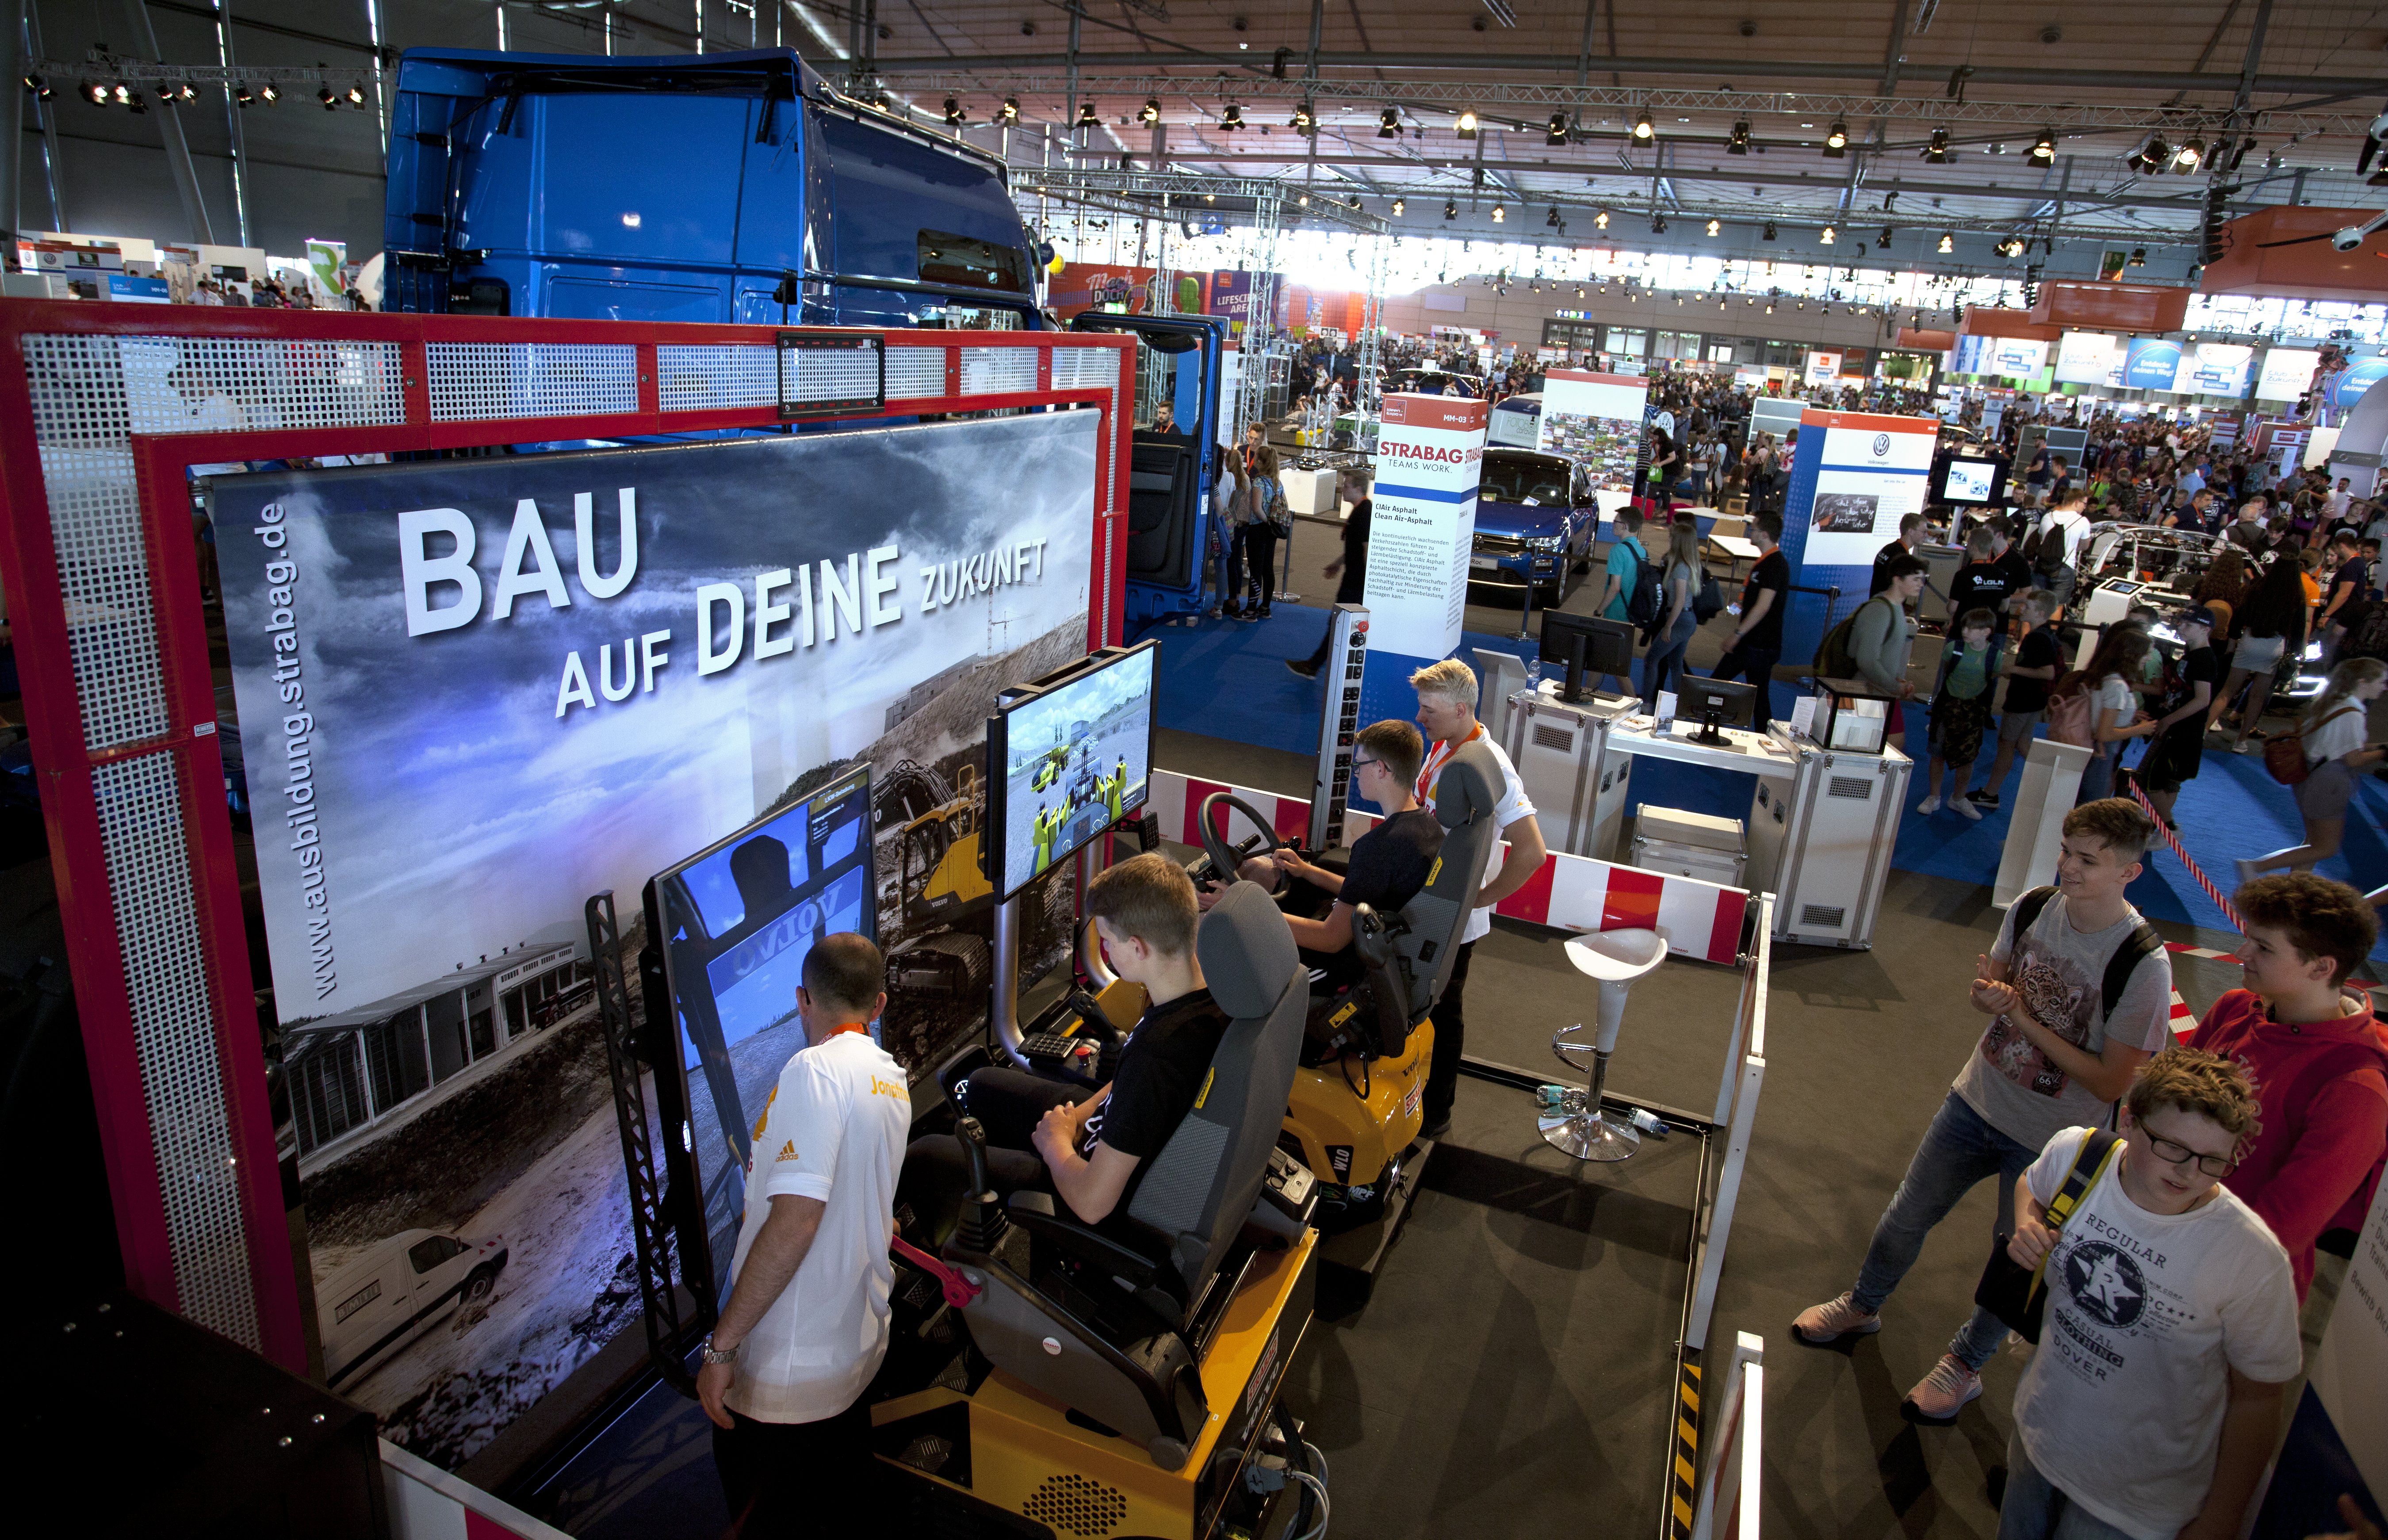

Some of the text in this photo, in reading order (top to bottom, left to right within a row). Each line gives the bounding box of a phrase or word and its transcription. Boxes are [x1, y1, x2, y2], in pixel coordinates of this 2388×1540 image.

[1086, 270, 1135, 290] Mach
[1094, 289, 1124, 302] DOCH
[2140, 359, 2170, 368] Entdecke
[2156, 368, 2173, 377] Weg!
[1443, 414, 1467, 423] MM-03
[1379, 441, 1463, 464] STRABAG
[1465, 445, 1483, 464] STRABAG
[1389, 459, 1453, 474] TEAMS WORK.
[1395, 515, 1432, 525] Air-Asphalt
[1835, 515, 1851, 524] how
[1860, 505, 1875, 520] why
[1372, 538, 1408, 547] Verkehrszahlen
[1382, 532, 1416, 541] kontinuierlich
[398, 487, 638, 638] BAU
[1371, 551, 1412, 561] Lärmbelästigung.
[1370, 564, 1406, 574] Asphaltschicht,
[1410, 563, 1437, 571] konzipierte
[1369, 571, 1412, 581] photokatalytische
[1405, 582, 1431, 591] Minderung
[1408, 589, 1444, 599] Lärmbelastung
[555, 536, 1047, 718] AUF DEINE ZUKUNFT
[254, 502, 337, 1001] www.ausbildung.strabag.de
[1429, 863, 1439, 882] VOLVO
[2039, 1076, 2051, 1085] 66
[871, 1075, 911, 1103] Jonatha
[1198, 1077, 1210, 1102] VOLVO
[1406, 1081, 1421, 1111] STRAB
[775, 1153, 799, 1162] adidas
[2085, 1213, 2167, 1269] REGULAR
[2065, 1308, 2114, 1350] CASUAL
[2056, 1311, 2121, 1367] CLOTHING
[2054, 1335, 2107, 1381] DOVER
[1248, 1338, 1278, 1403] STRABAG
[1241, 1360, 1280, 1441] VOLVO
